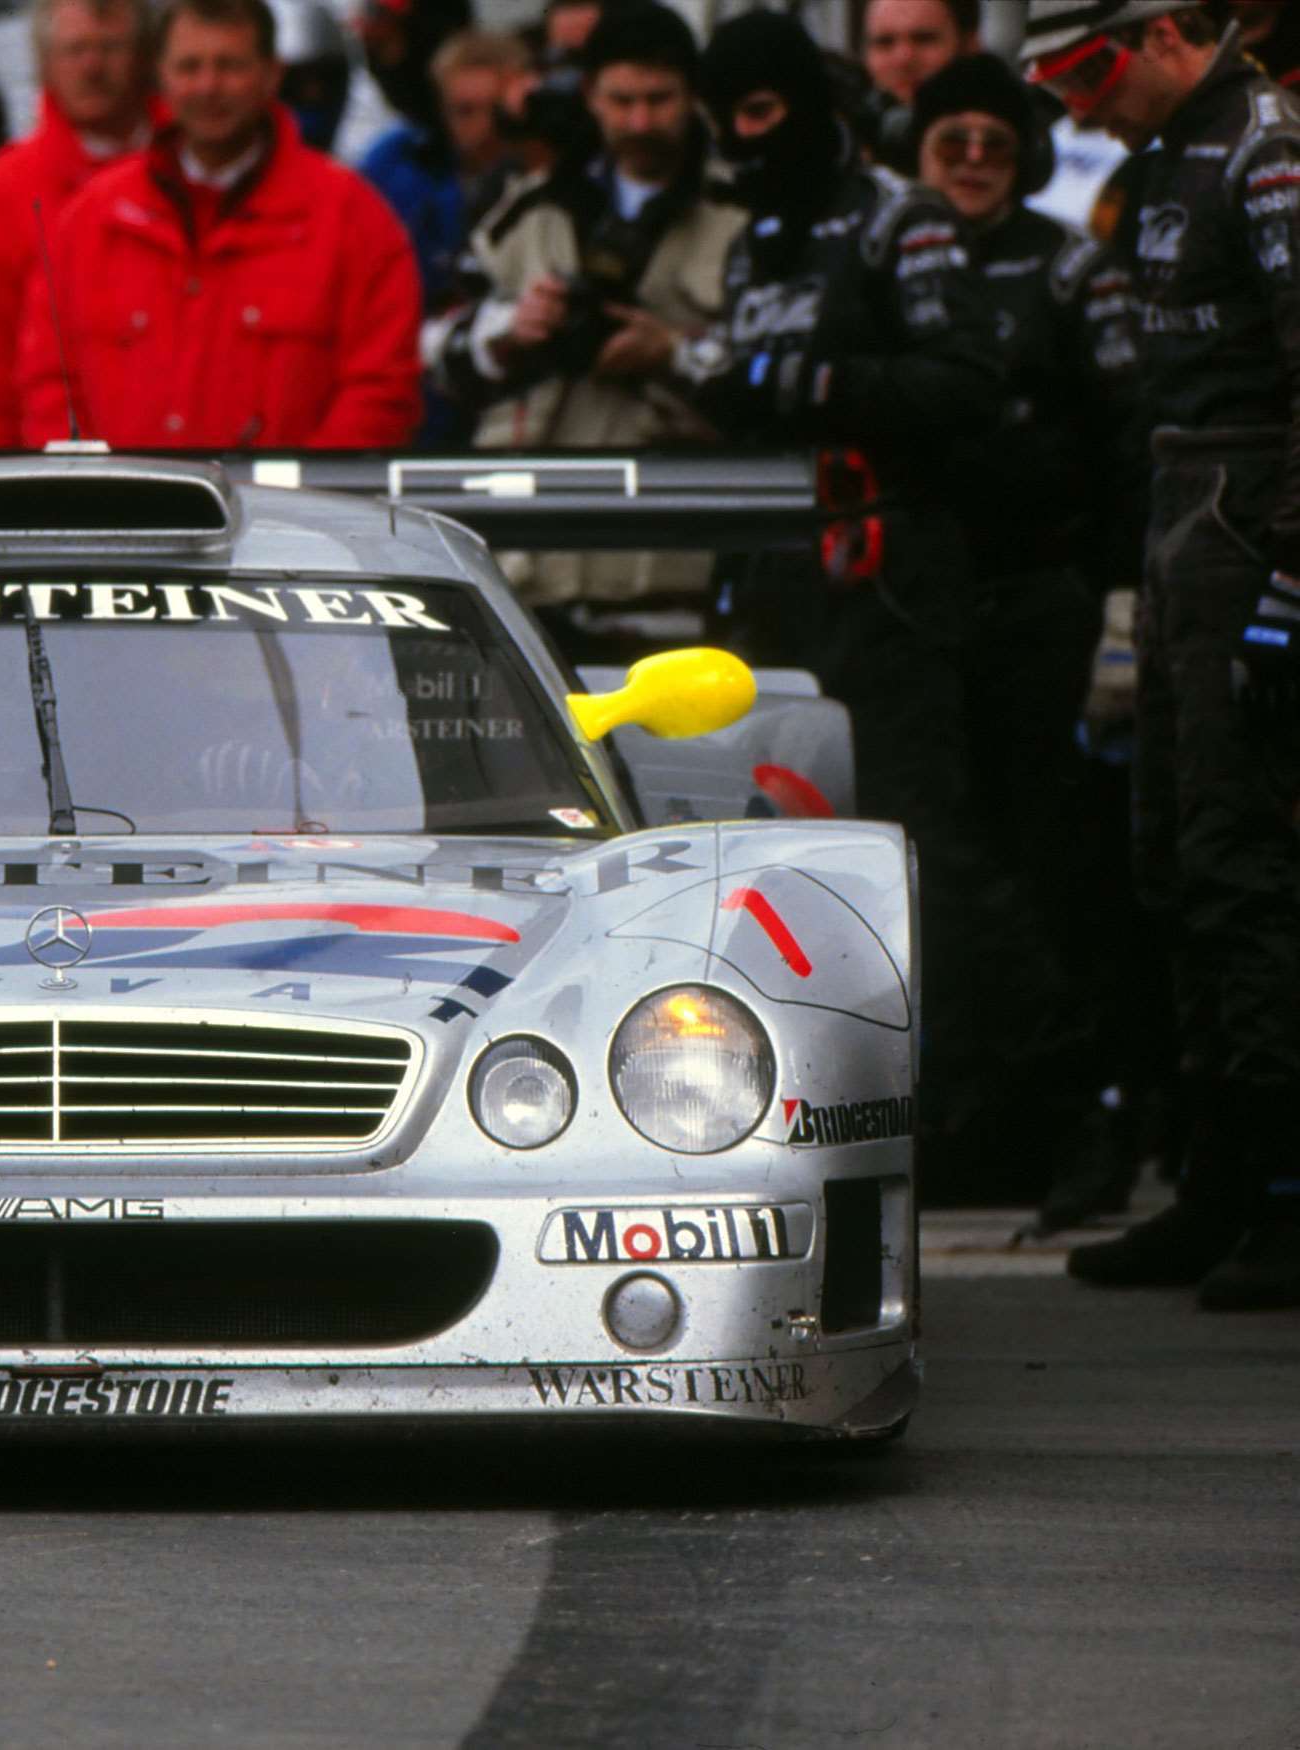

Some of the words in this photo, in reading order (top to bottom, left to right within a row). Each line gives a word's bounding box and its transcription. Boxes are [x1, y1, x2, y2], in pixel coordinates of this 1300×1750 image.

[10, 1198, 165, 1221] AMG
[562, 1208, 741, 1262] Mobil
[529, 1362, 806, 1405] WARSTEINER
